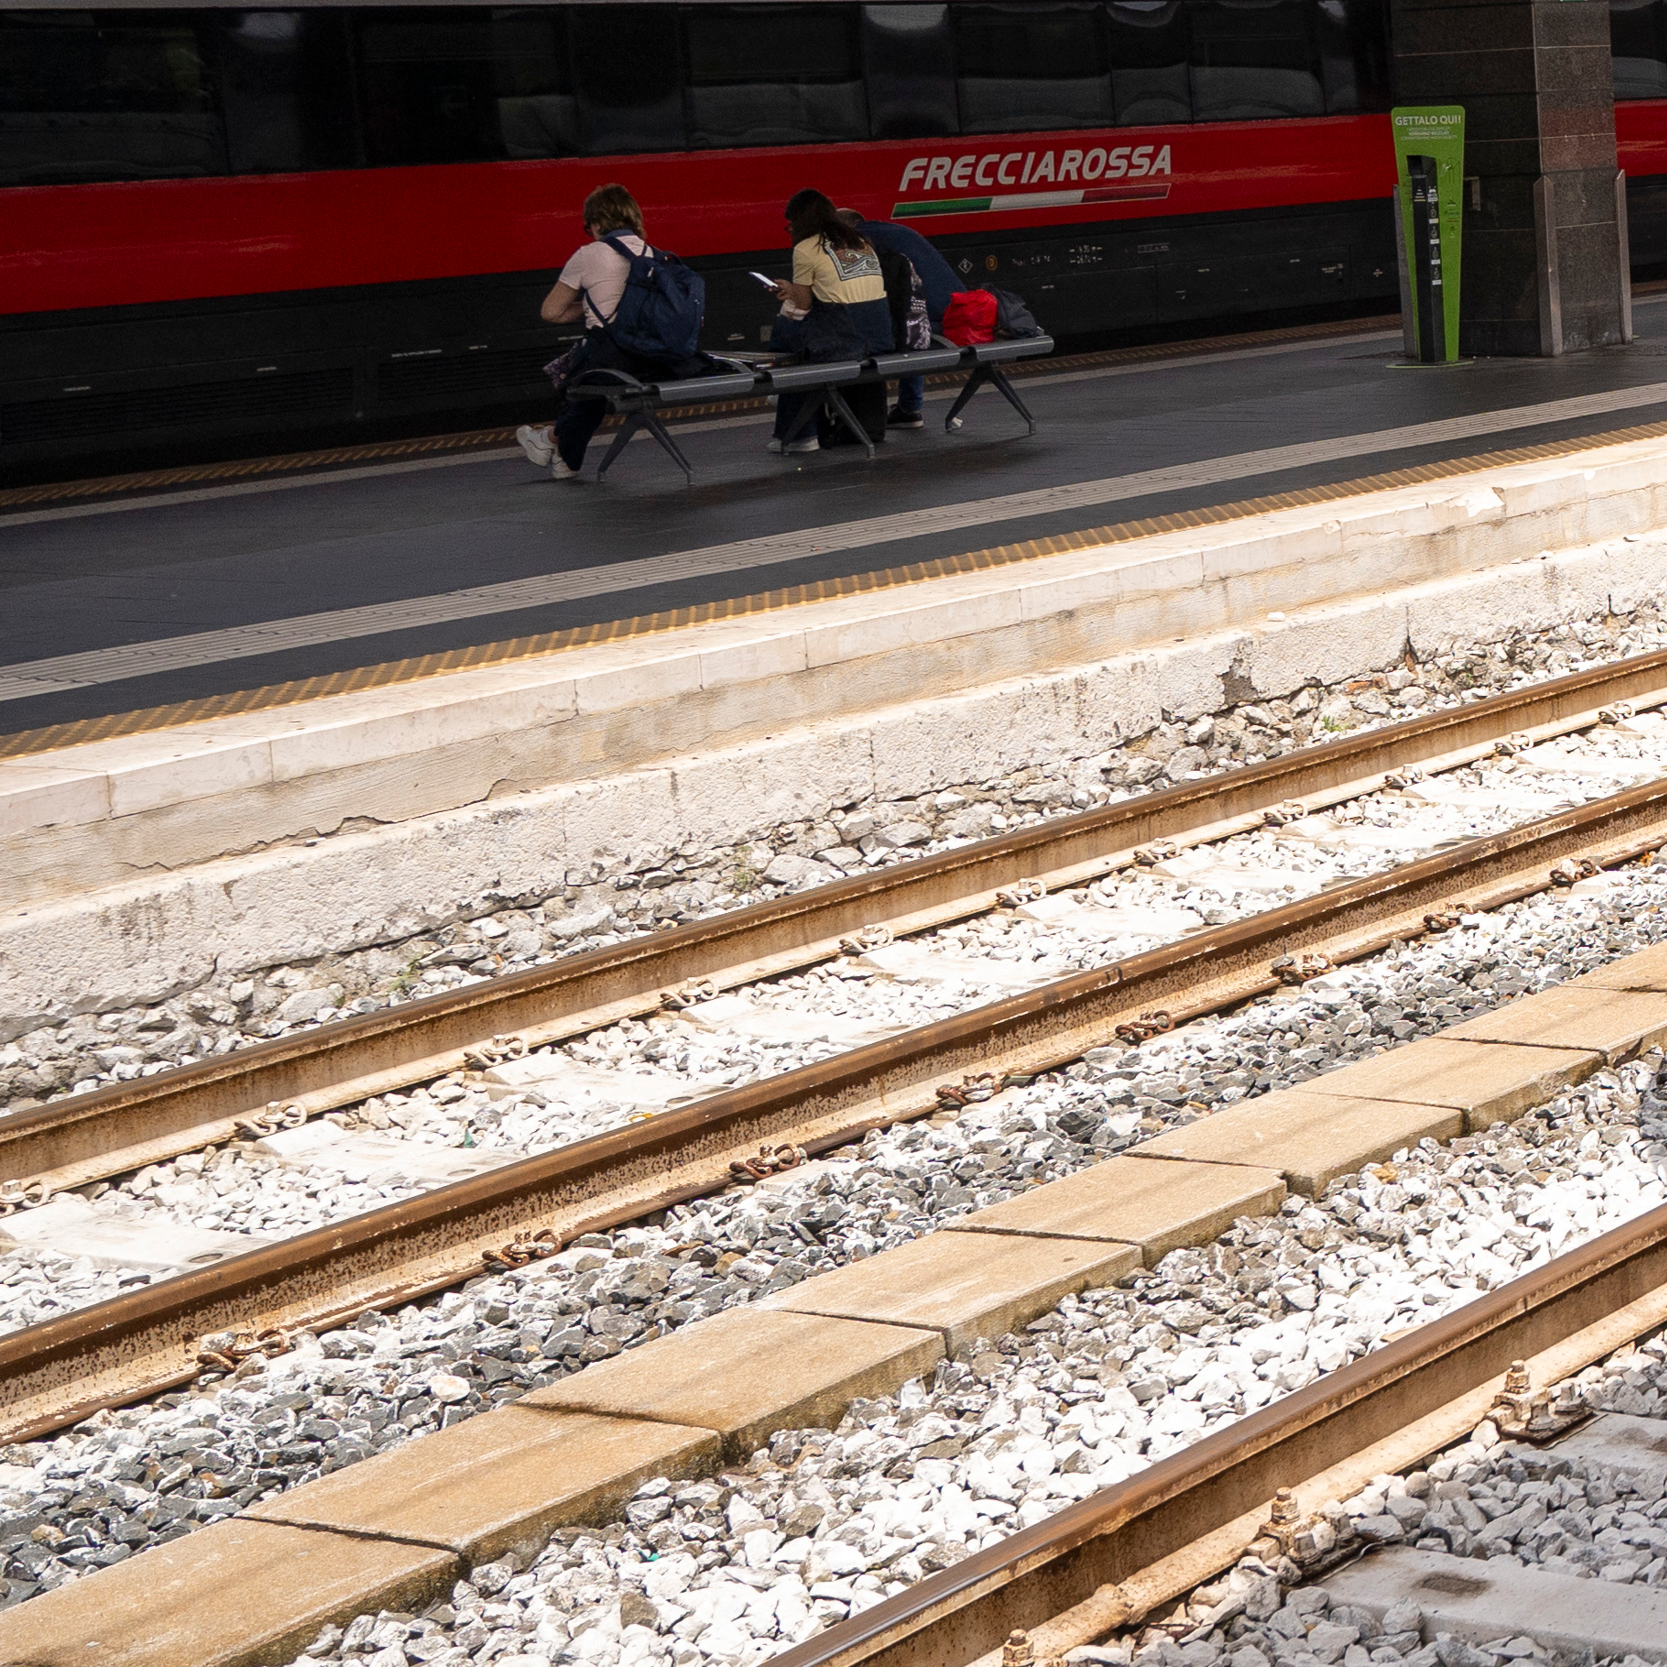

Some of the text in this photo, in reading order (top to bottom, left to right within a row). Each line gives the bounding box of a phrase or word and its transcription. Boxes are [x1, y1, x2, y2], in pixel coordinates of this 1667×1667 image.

[1395, 114, 1462, 126] GETTALO QUI!
[898, 144, 1172, 192] FRECCIAROSSA
